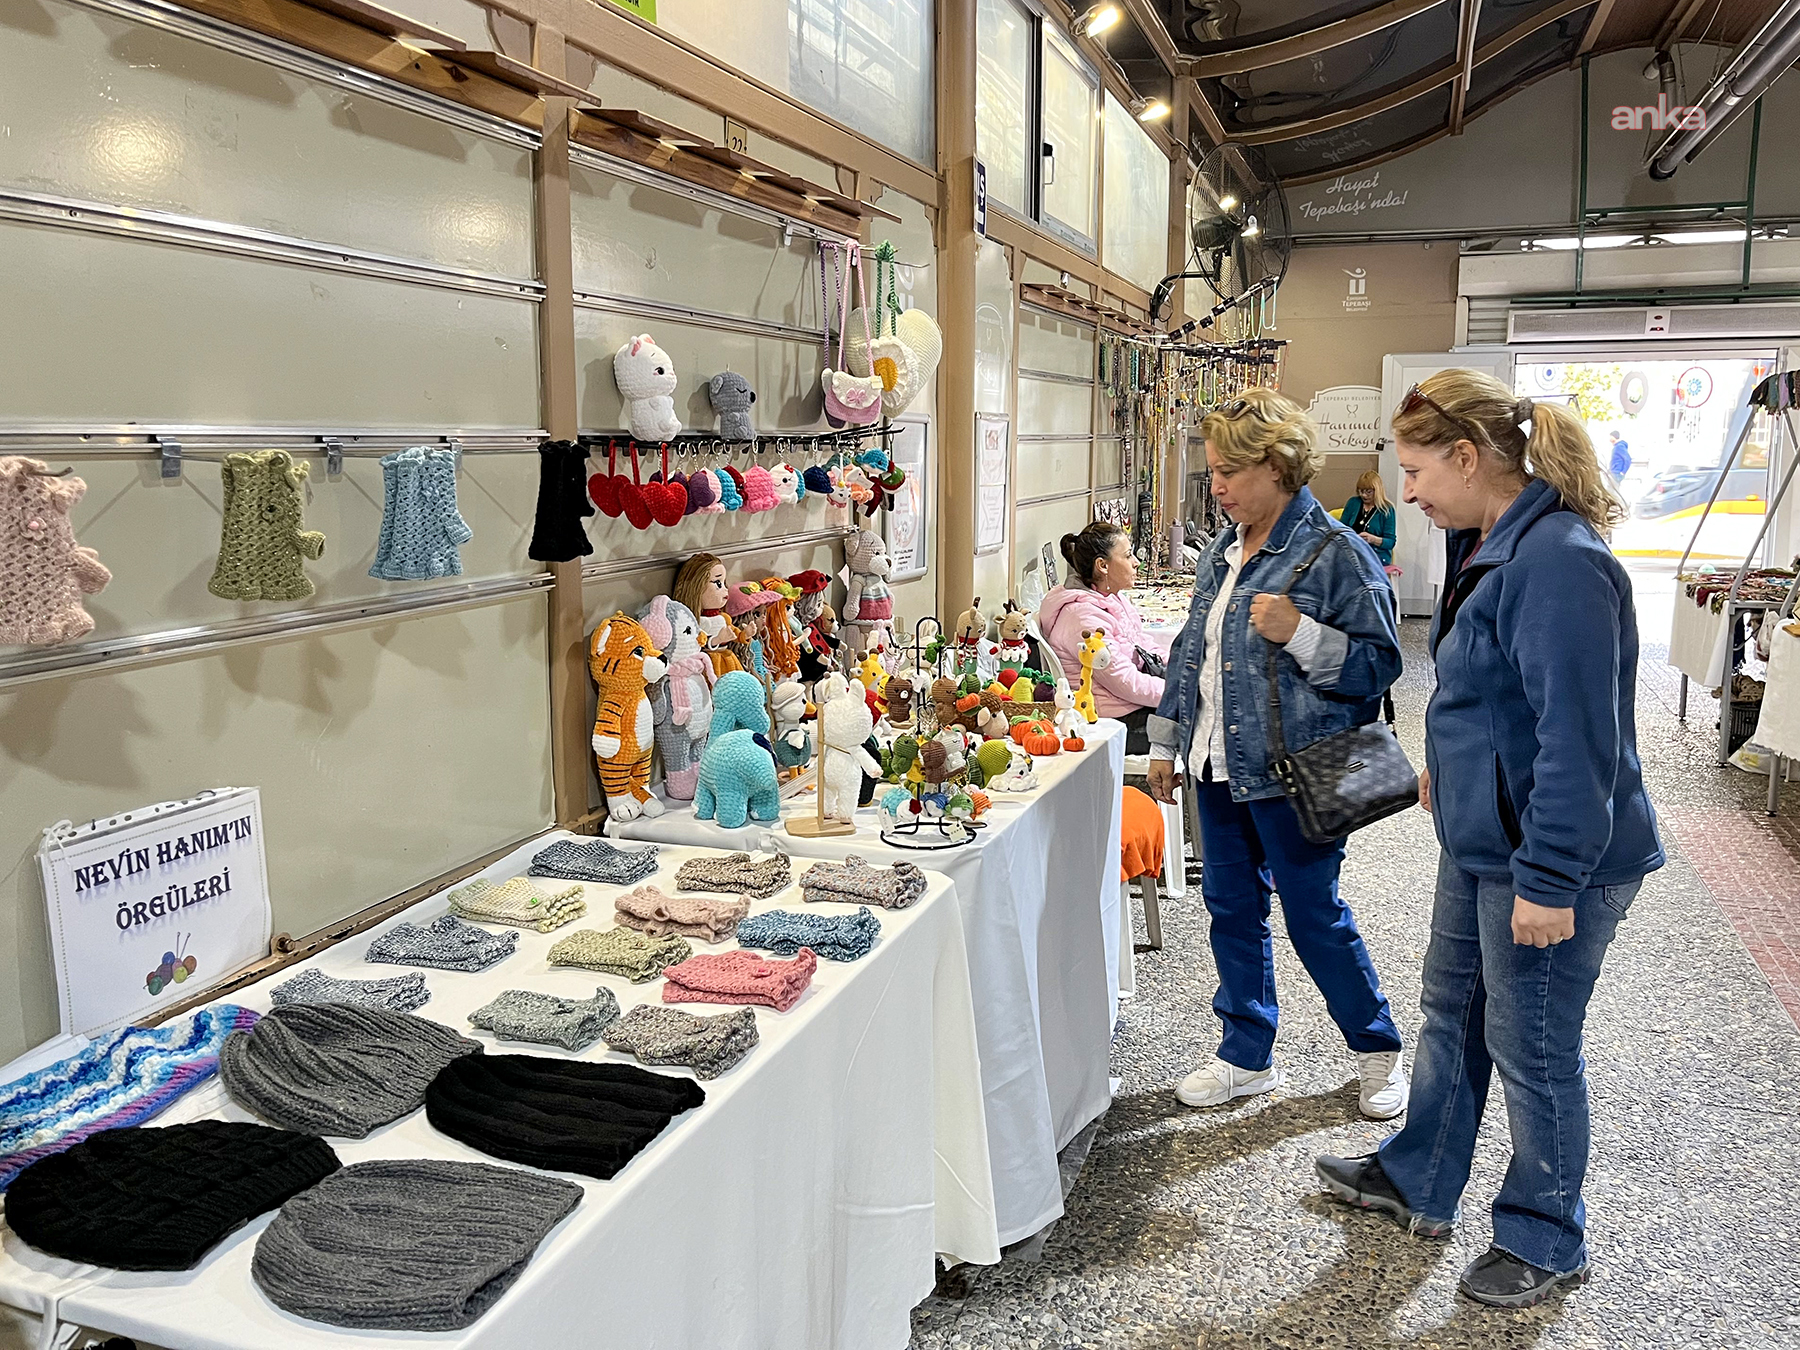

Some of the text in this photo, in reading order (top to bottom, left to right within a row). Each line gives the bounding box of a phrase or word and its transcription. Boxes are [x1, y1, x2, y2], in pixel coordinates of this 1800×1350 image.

[1326, 171, 1380, 196] Hayat
[1299, 190, 1408, 222] Tepebaşı'nda!
[1341, 300, 1371, 308] TEPEBAŞI
[1317, 412, 1381, 433] Hanımel
[74, 847, 150, 892] NEVİN
[115, 866, 232, 930] ÖRGÜLERİ
